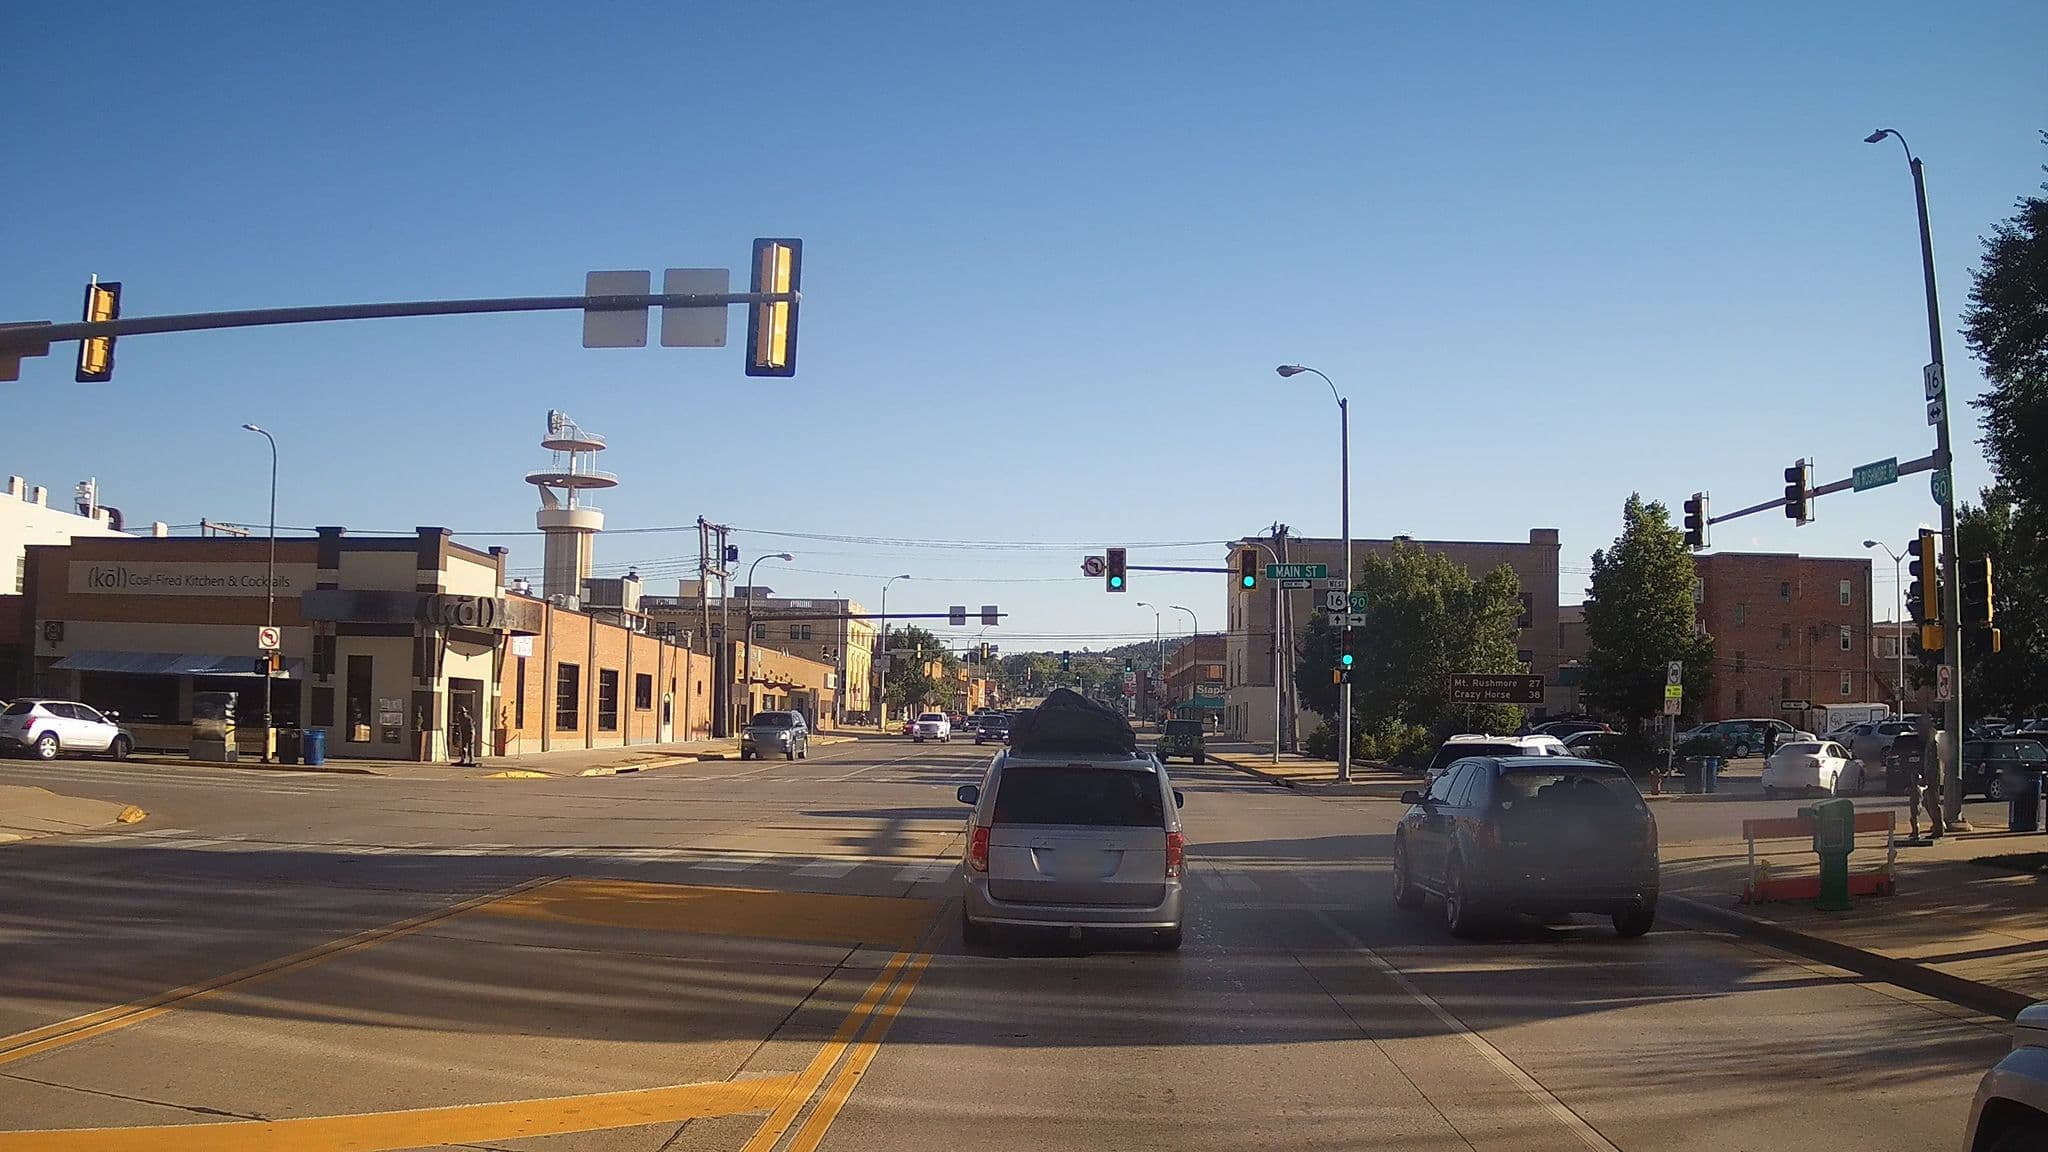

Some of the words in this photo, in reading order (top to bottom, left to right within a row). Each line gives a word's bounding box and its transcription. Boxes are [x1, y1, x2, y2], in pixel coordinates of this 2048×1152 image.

[1927, 370, 1939, 391] 16
[1933, 480, 1947, 498] 90
[1276, 566, 1300, 577] MAIN
[1305, 566, 1317, 577] ST
[129, 574, 182, 586] Coal-Fired
[185, 575, 225, 587] Kitchen
[228, 576, 238, 587] &
[241, 576, 290, 588] Cockails
[1330, 595, 1343, 606] 16
[1351, 597, 1365, 608] 90
[1454, 679, 1469, 687] Mt.
[1472, 679, 1517, 687] Rushmore
[1454, 690, 1480, 700] Crazy
[1484, 690, 1511, 699] Horse
[1528, 691, 1541, 699] 38
